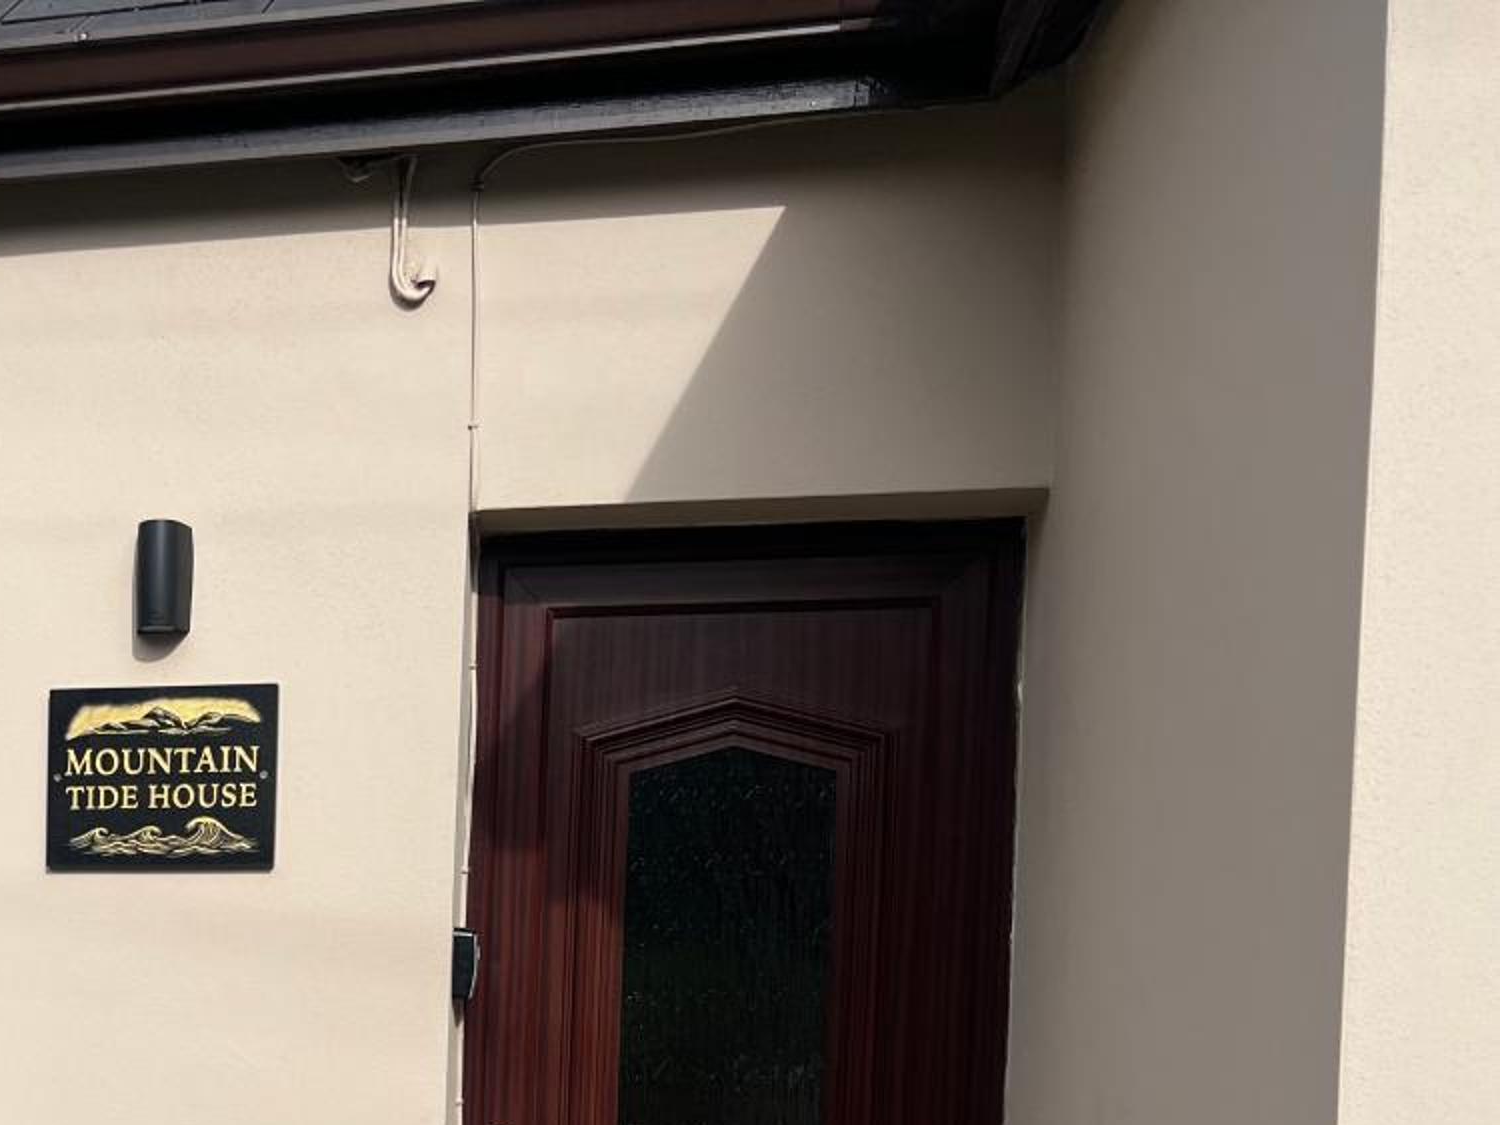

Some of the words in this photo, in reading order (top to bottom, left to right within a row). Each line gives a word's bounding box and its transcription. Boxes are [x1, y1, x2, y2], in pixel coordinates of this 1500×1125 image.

[65, 745, 260, 776] MOUNTAIN
[65, 785, 140, 810] TIDE
[148, 783, 258, 809] HOUSE
